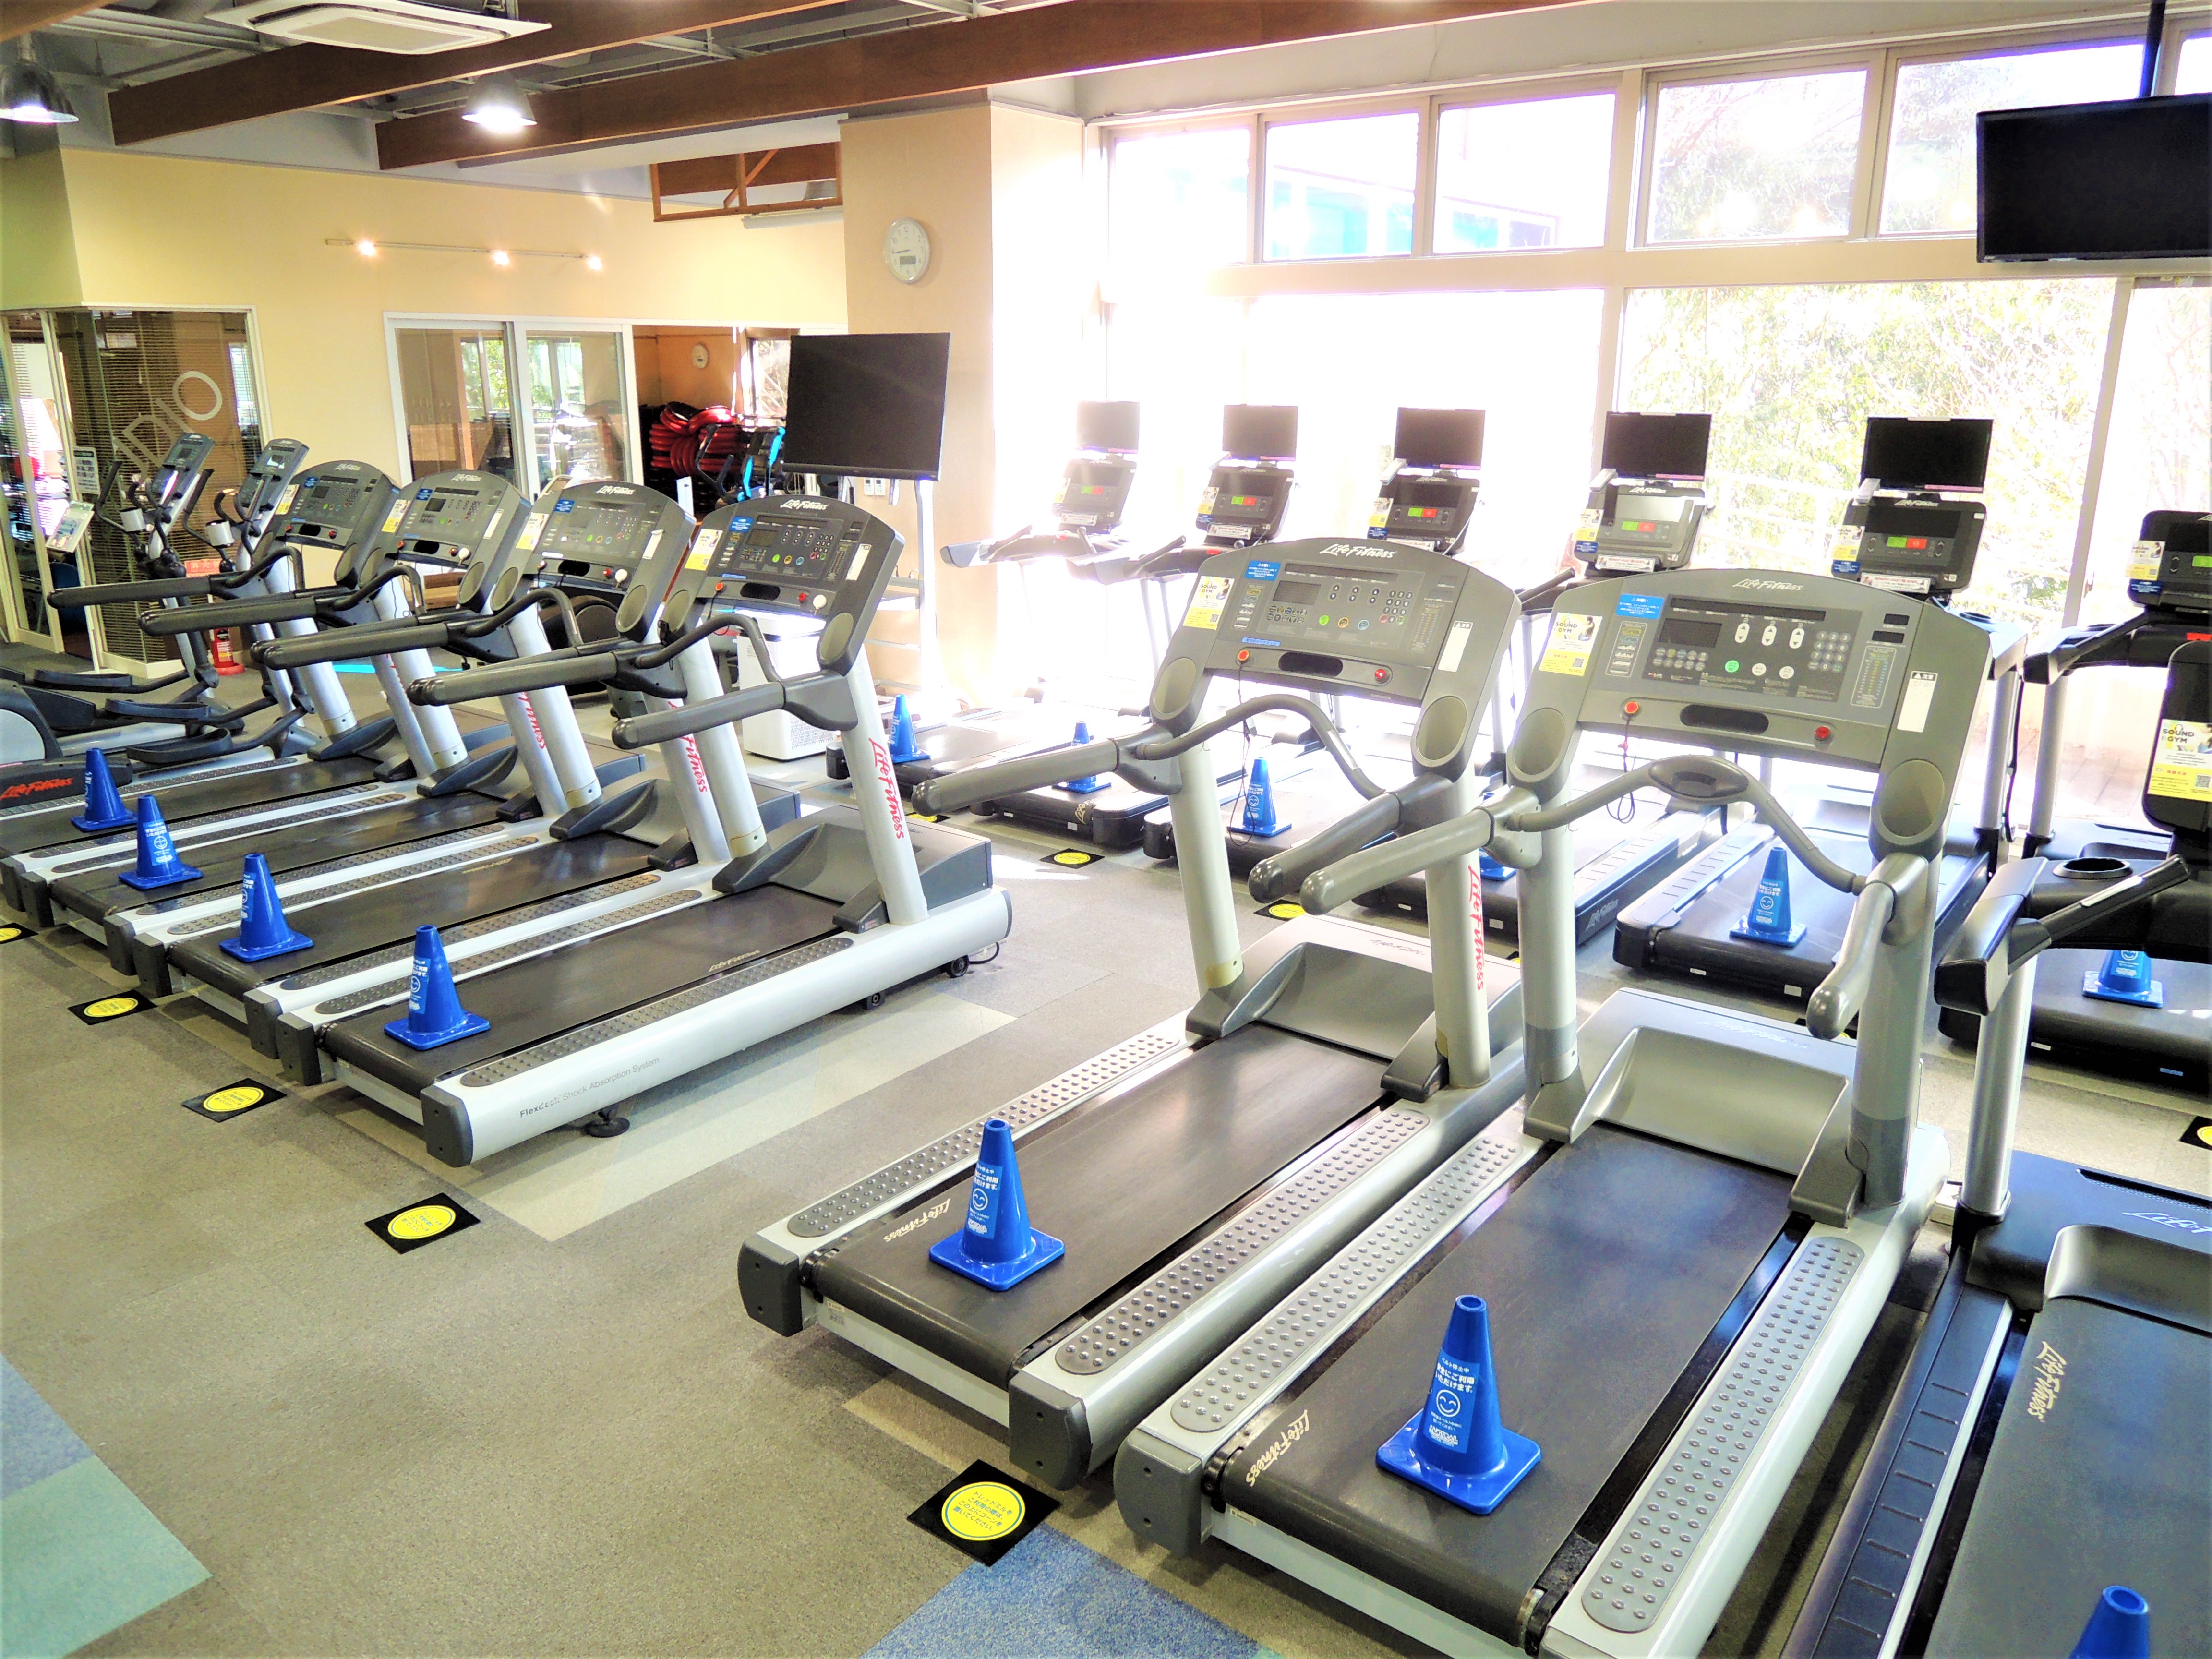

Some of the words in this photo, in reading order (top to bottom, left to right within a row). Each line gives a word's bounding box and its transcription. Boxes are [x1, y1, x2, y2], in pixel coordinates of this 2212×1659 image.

[2162, 729, 2194, 737] SOUND
[563, 1085, 587, 1101] Shock
[589, 1069, 631, 1090] Absorption
[632, 1057, 660, 1073] System
[959, 1501, 1003, 1527] この上にコーンを
[973, 1491, 1013, 1515] トレッドミルを
